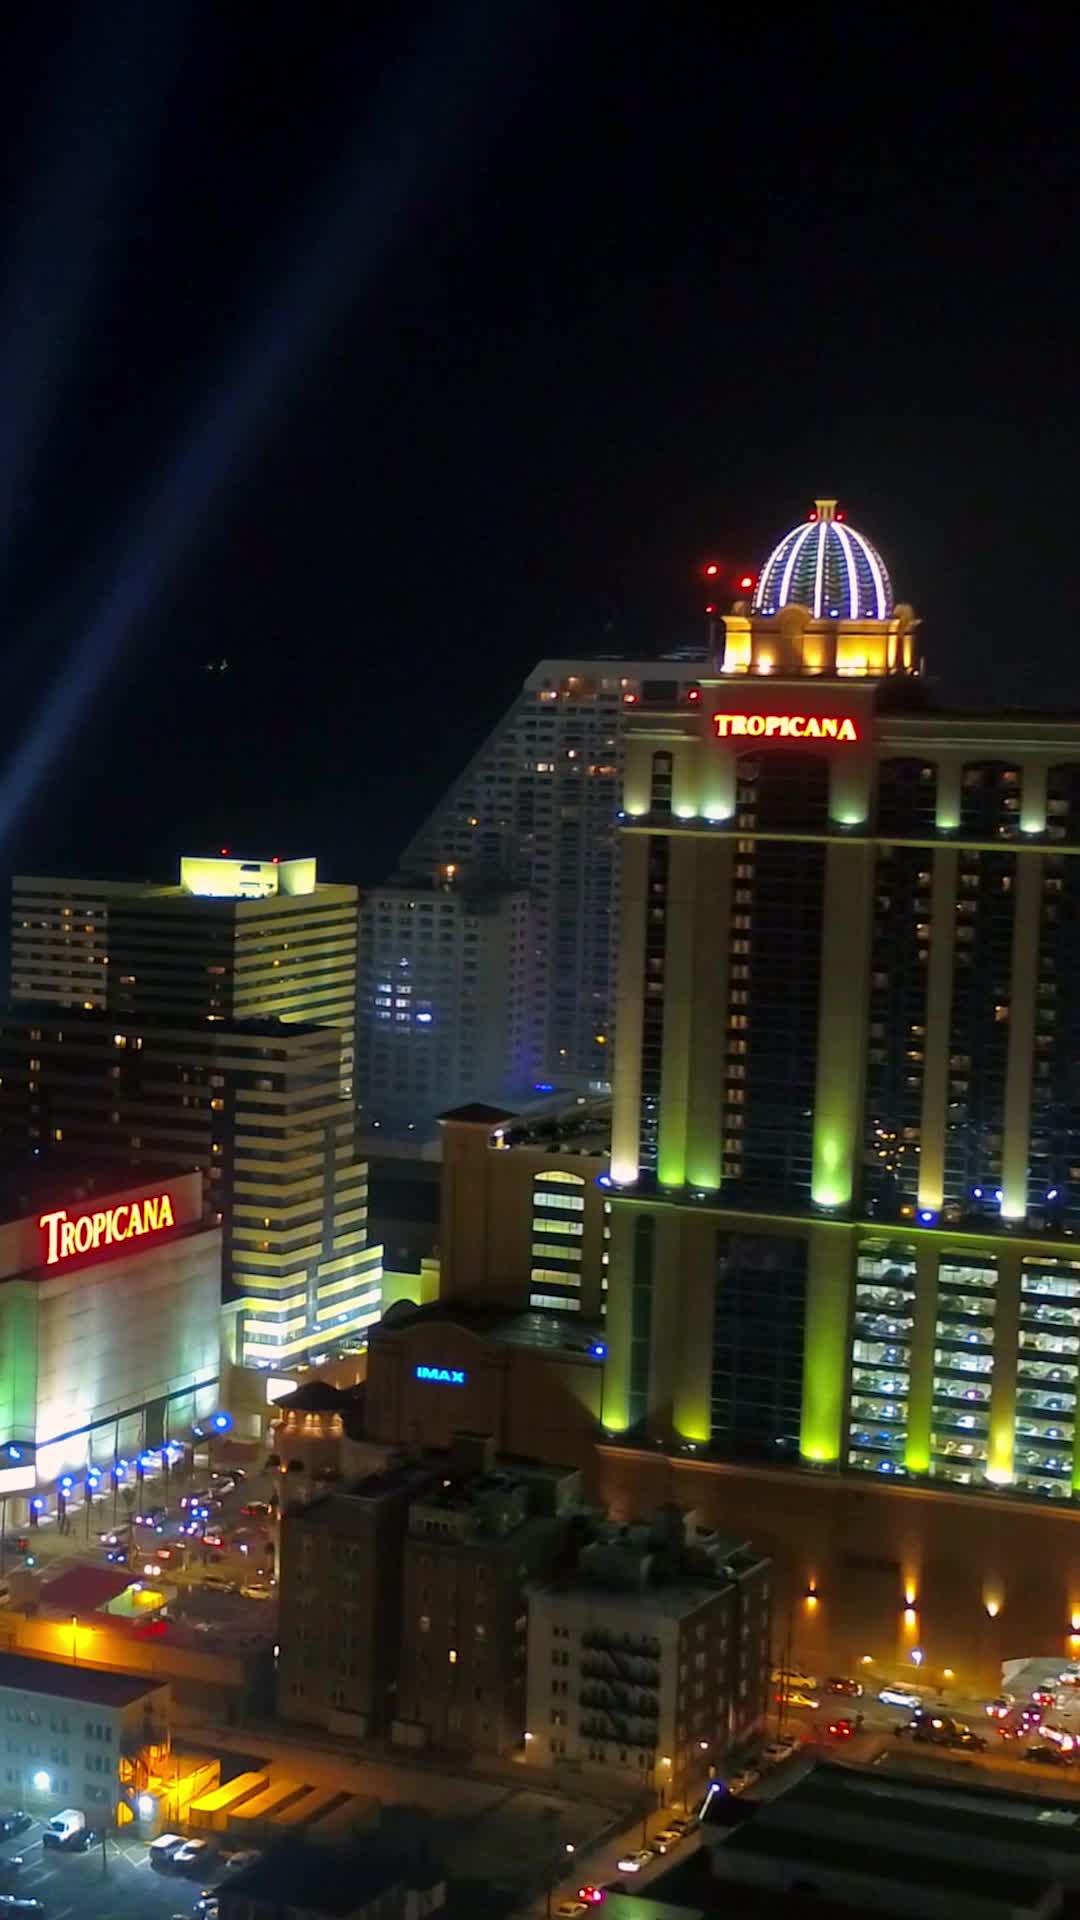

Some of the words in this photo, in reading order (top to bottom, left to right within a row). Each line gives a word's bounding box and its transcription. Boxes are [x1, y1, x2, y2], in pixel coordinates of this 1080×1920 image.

[714, 714, 857, 740] TROPICANA
[39, 1195, 174, 1264] TROPICANA
[417, 1366, 465, 1383] IMAX
